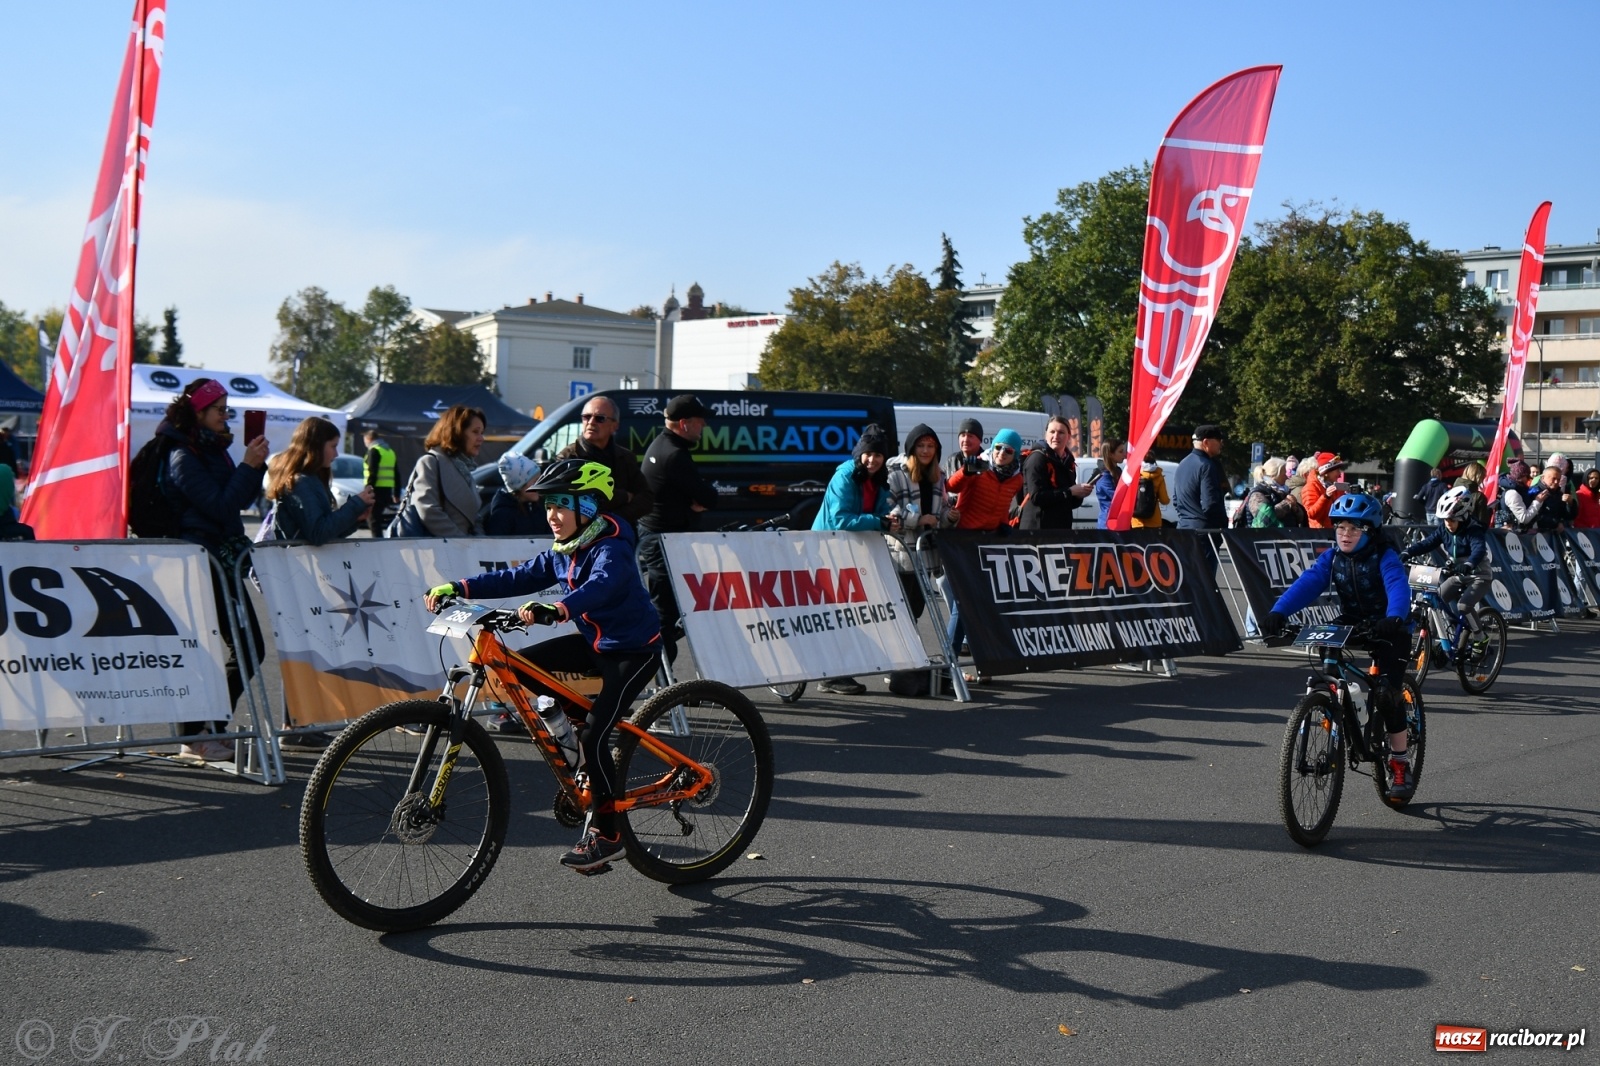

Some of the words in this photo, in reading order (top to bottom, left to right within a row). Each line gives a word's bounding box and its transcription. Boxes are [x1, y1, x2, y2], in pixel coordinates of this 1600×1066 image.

[710, 399, 768, 416] atelier
[1254, 447, 1262, 459] P
[343, 561, 352, 569] N
[980, 544, 1181, 600] TREZADO
[1416, 574, 1432, 584] 298
[682, 567, 868, 612] YAKIMA
[310, 606, 322, 616] W
[394, 599, 401, 609] E
[445, 610, 472, 624] 288
[746, 618, 790, 644] TAKE
[789, 611, 835, 637] MORE
[835, 601, 897, 628] FRIENDS
[1012, 621, 1116, 657] USZCZELNIAMY
[1115, 616, 1201, 648] NAJLEPSZYCH
[1306, 632, 1335, 640] 267
[181, 639, 198, 649] TM
[367, 648, 374, 657] S
[91, 651, 184, 675] jedziesz
[75, 685, 190, 700] www.taurus.info.pl
[464, 840, 497, 891] KENDA
